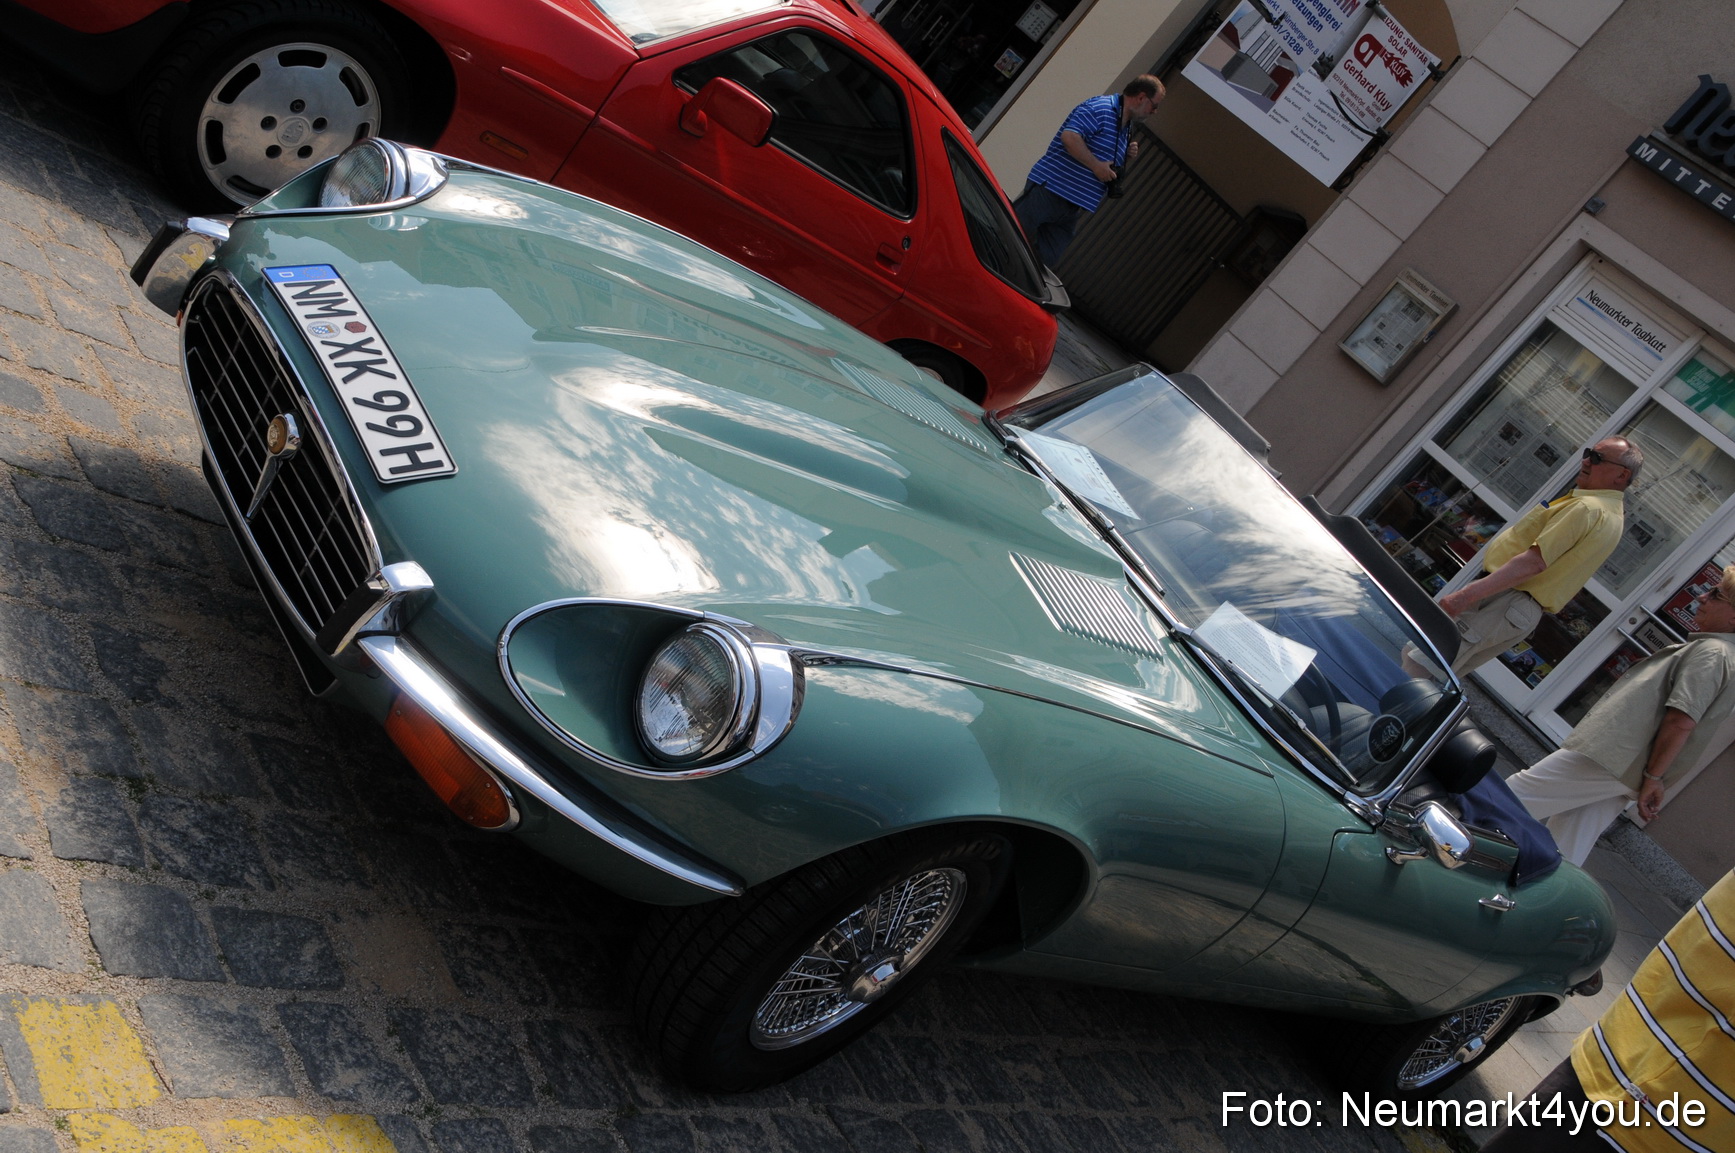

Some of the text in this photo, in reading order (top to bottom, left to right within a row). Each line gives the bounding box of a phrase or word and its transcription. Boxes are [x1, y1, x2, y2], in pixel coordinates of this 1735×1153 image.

[1292, 0, 1323, 32] eizungen
[1306, 0, 1342, 31] penglerei
[1306, 40, 1314, 52] Str.
[1388, 36, 1408, 57] SOLAR
[1405, 38, 1428, 65] SANITÄR
[1390, 60, 1407, 77] KLUY
[1344, 59, 1377, 94] Gerhard
[1374, 89, 1392, 112] Kluy
[1635, 142, 1735, 219] MITTE
[283, 280, 357, 319] NM
[320, 336, 397, 385] XK
[1585, 289, 1666, 353] Neumarkter Tagblatt
[1644, 628, 1665, 649] Neum
